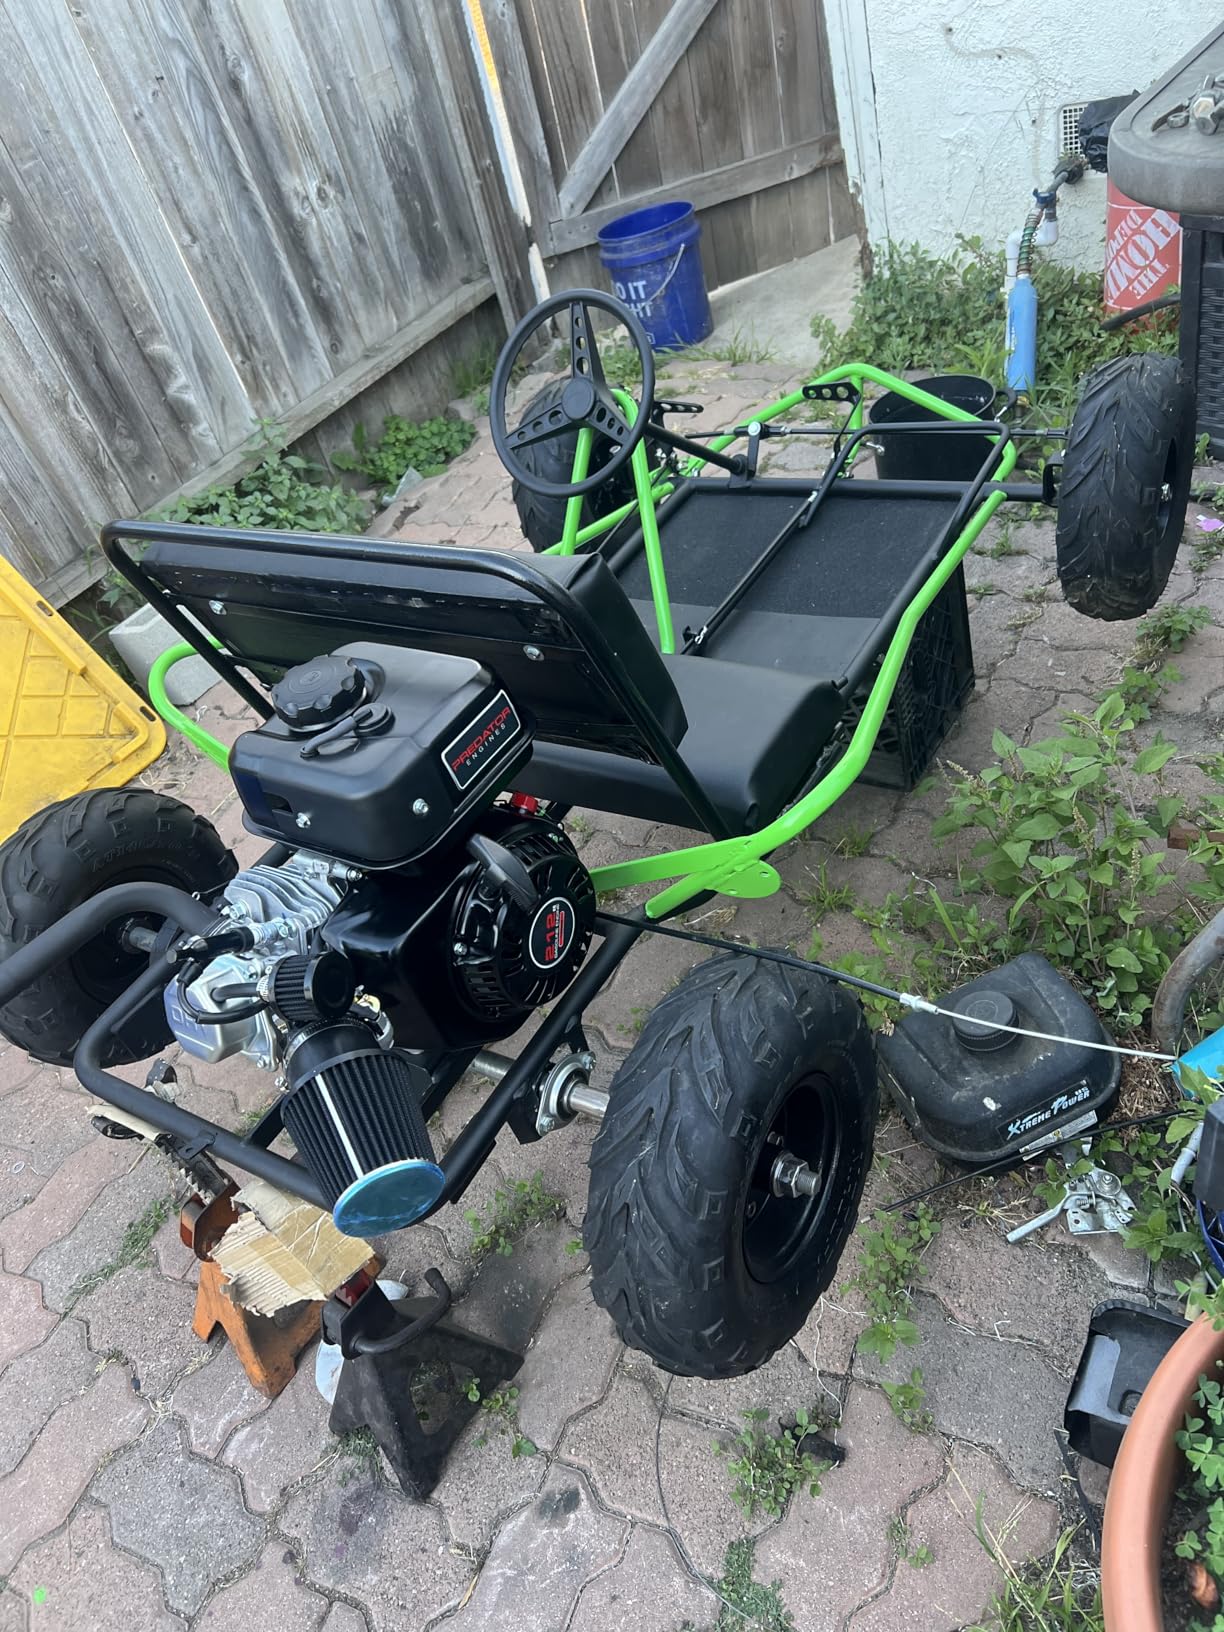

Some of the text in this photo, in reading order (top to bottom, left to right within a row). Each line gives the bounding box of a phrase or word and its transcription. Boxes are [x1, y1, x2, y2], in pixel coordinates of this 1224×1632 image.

[628, 280, 647, 300] IT
[1129, 258, 1170, 299] THE
[451, 706, 511, 772] PREDATOR
[466, 722, 506, 766] ENGINES
[545, 912, 556, 961] 212
